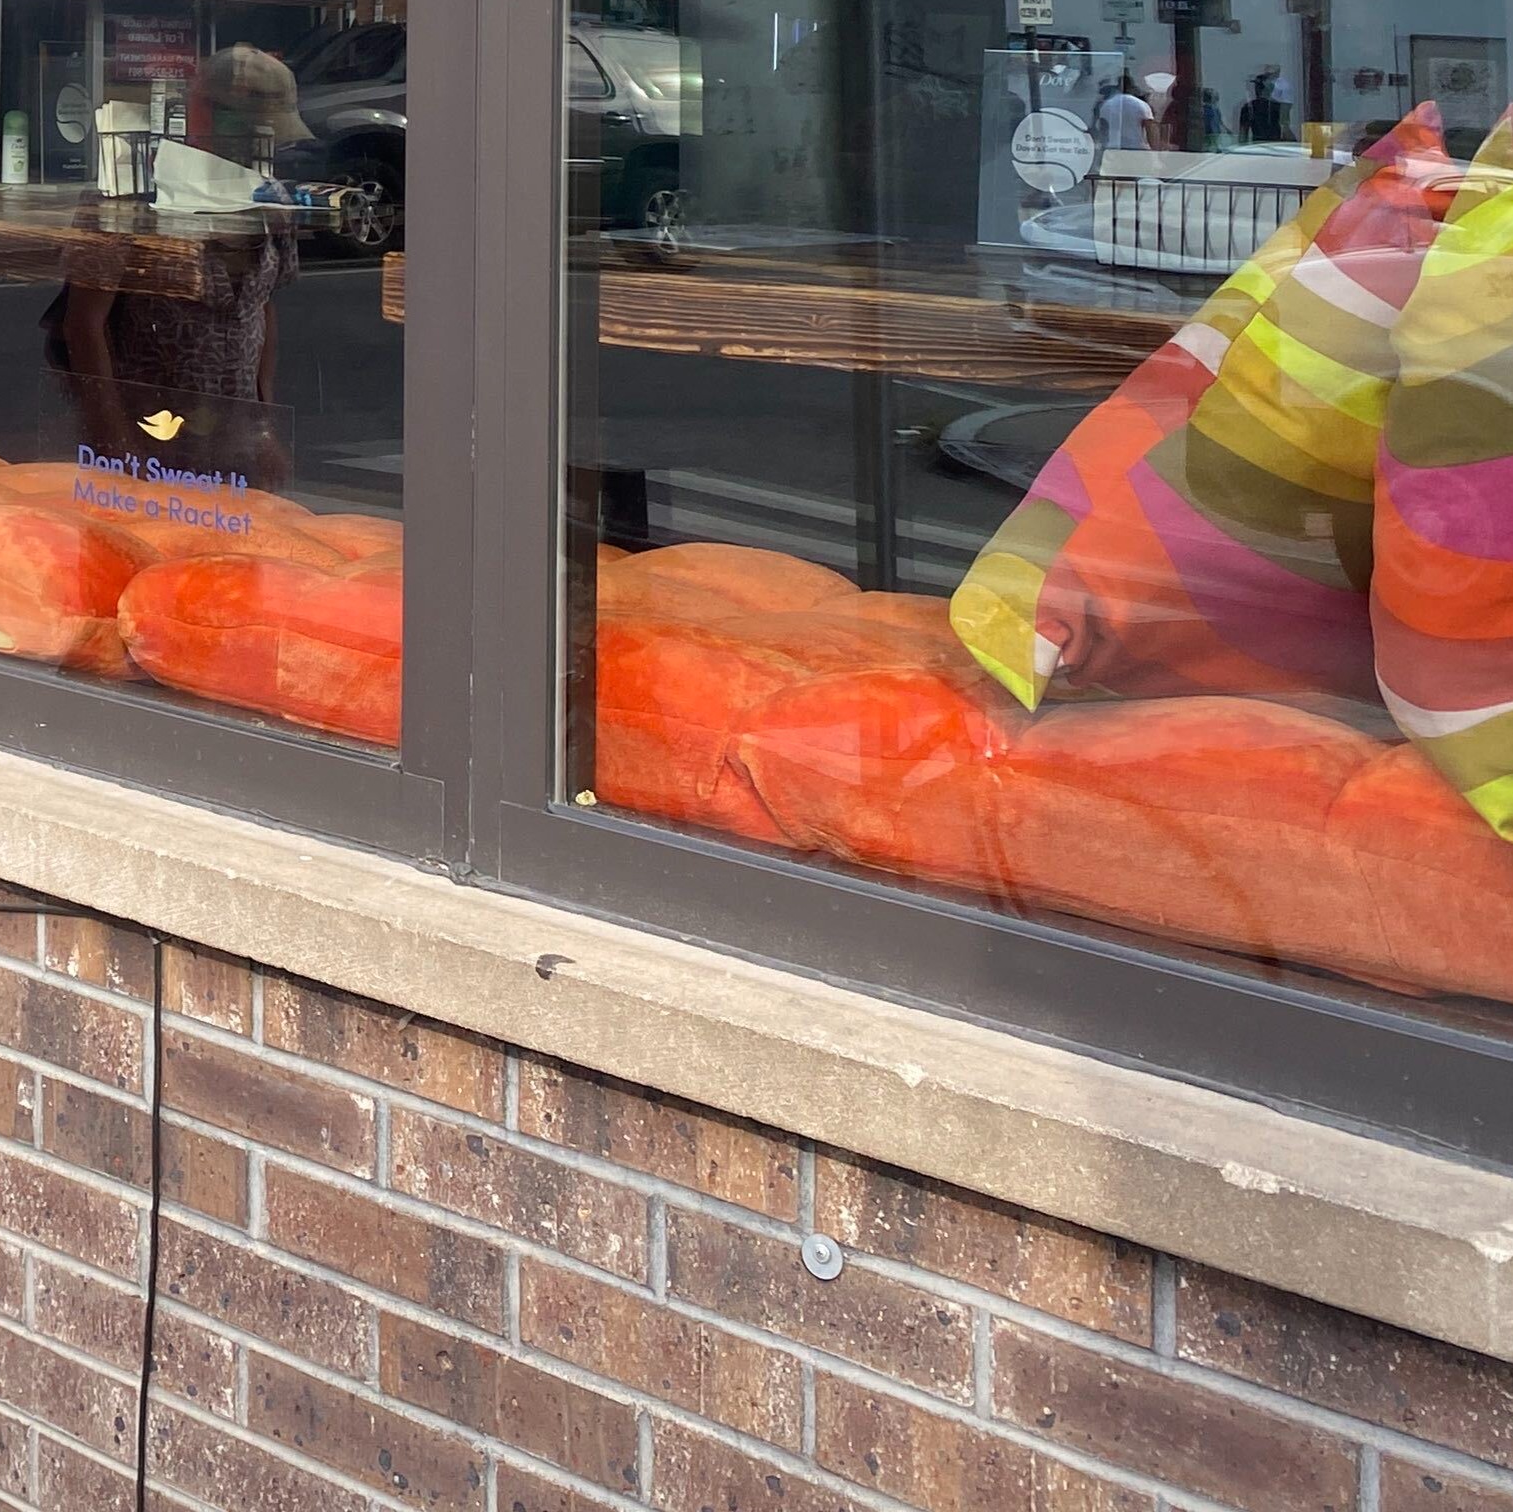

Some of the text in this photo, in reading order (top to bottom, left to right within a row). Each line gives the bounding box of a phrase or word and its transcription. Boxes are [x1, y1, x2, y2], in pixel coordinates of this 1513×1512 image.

[1039, 72, 1072, 86] Dove
[78, 443, 248, 499] Don't Sweat It
[72, 477, 252, 535] Make a Racket
